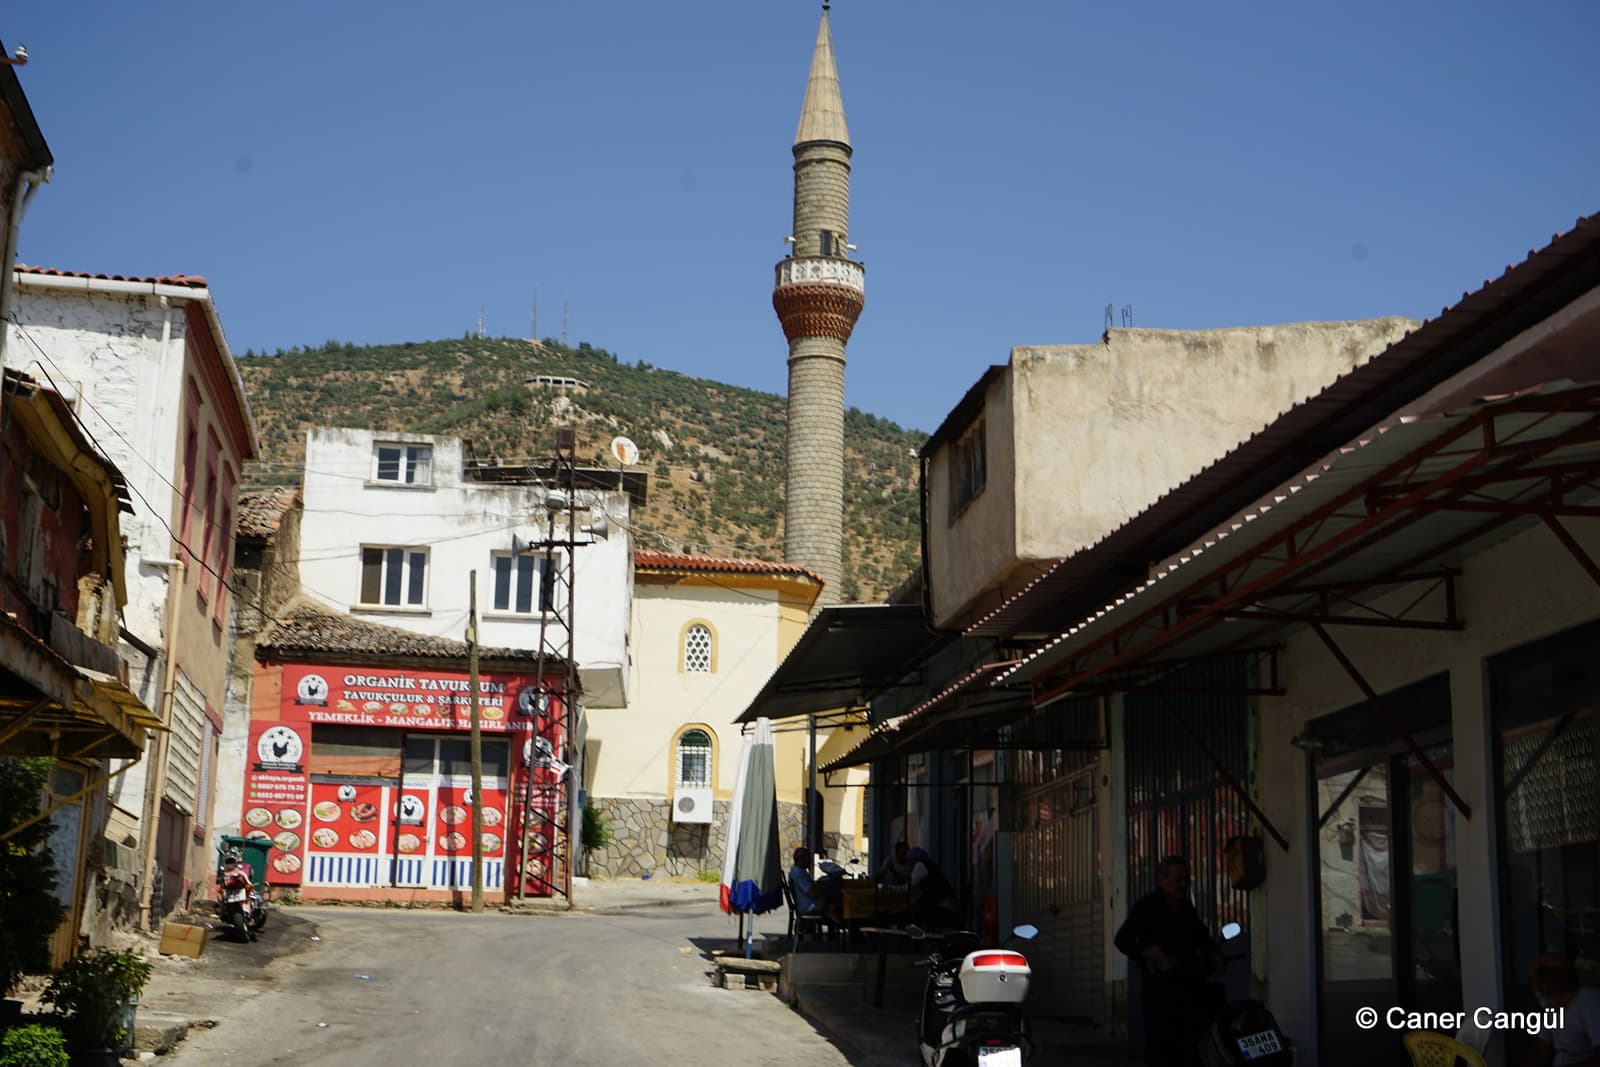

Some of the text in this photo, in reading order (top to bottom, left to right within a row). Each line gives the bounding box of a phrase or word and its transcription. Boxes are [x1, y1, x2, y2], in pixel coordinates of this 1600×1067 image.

[343, 674, 504, 693] ORGANİK TAVUKUM
[343, 690, 423, 704] TAVUKÇULUK
[426, 694, 435, 704] &
[308, 711, 376, 725] YEMEKLİK
[386, 716, 455, 728] MANGALIK
